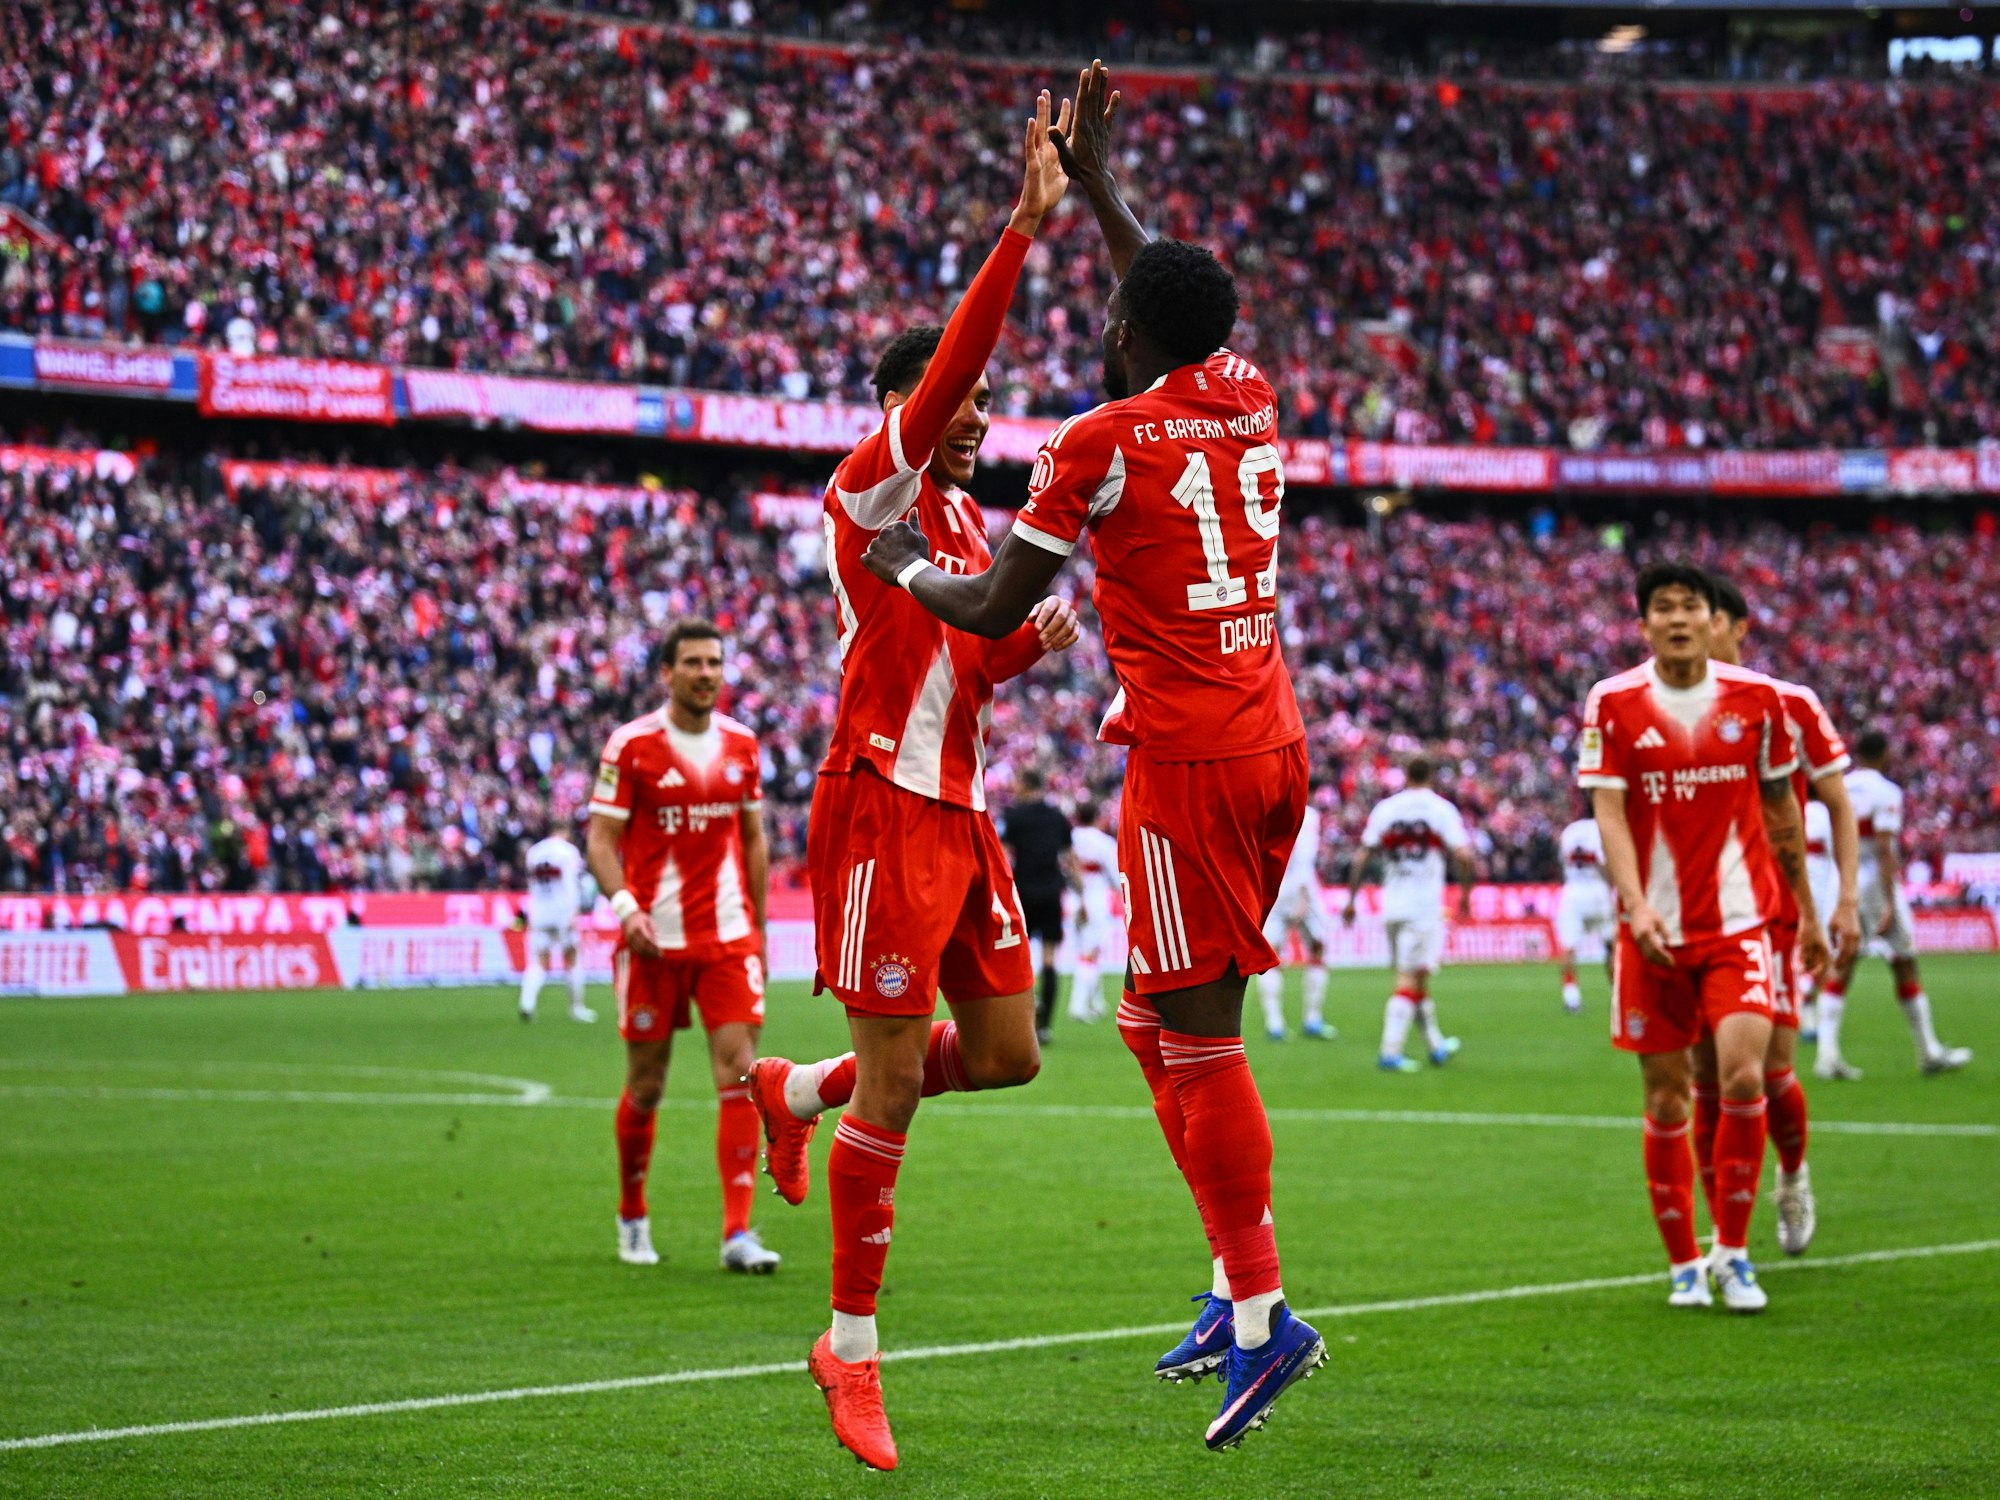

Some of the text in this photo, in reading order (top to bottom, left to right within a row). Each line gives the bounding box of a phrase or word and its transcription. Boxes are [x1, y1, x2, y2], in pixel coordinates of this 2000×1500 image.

[1133, 403, 1275, 444] FC BAYERN MÜNCHE
[1170, 443, 1285, 611] 19
[1220, 611, 1274, 655] DAVI
[1672, 764, 1748, 784] MAGENTA
[1673, 784, 1697, 802] TV
[687, 802, 741, 819] MAGE
[51, 896, 292, 936] MAGENTA
[138, 935, 320, 991] Emirates
[744, 954, 764, 996] 8
[1740, 940, 1767, 982] 3
